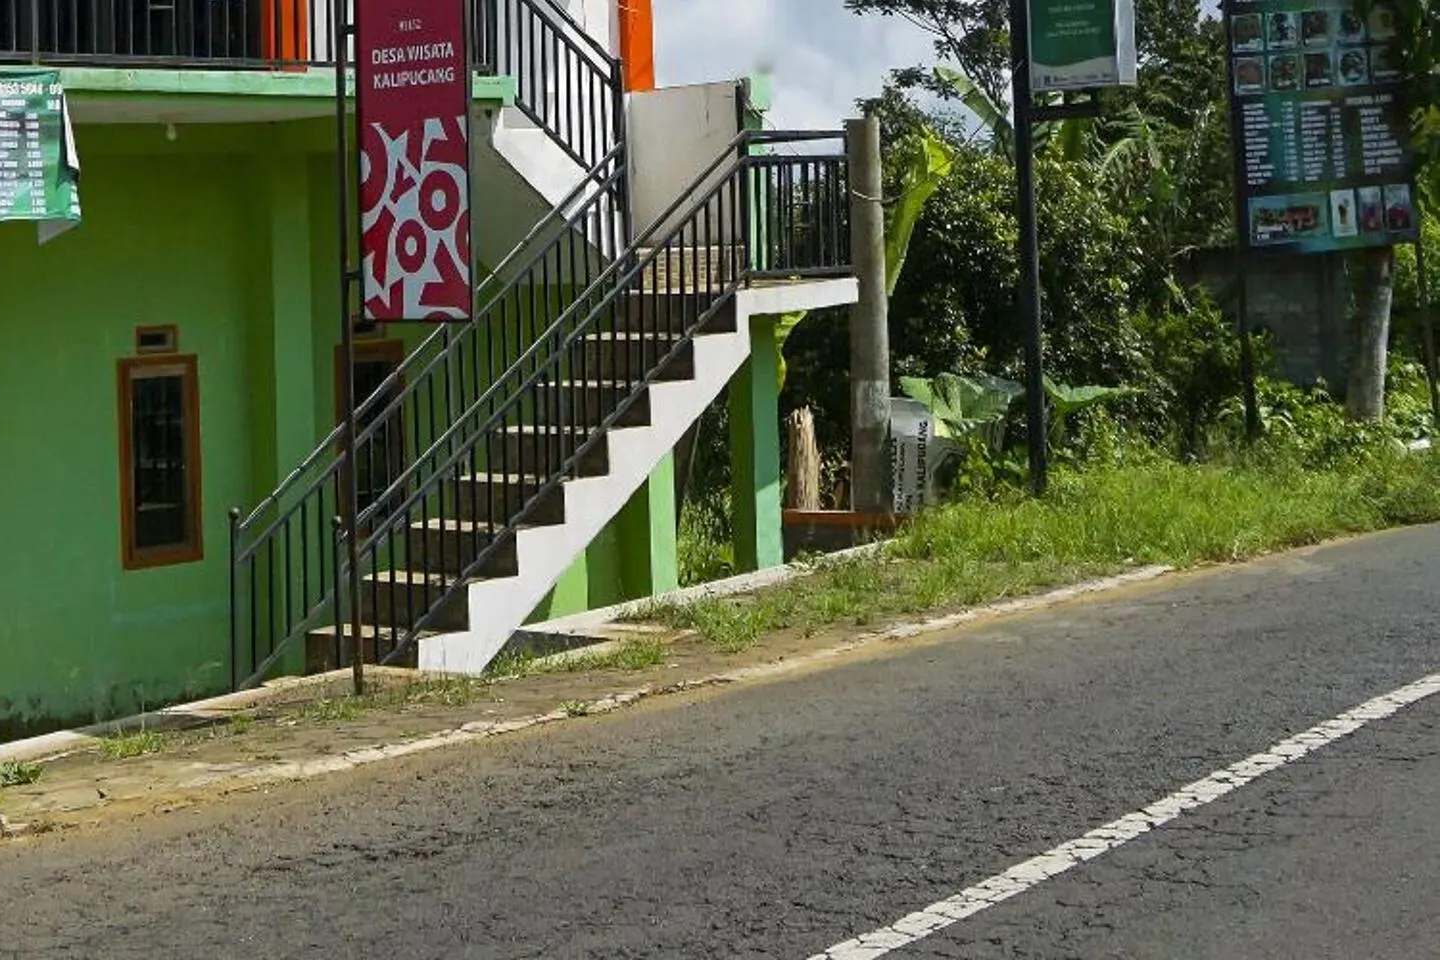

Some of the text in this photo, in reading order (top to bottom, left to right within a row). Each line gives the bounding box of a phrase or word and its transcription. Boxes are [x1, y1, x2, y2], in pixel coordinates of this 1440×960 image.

[372, 42, 454, 64] DESA WISATA
[373, 67, 455, 89] KALIPUCANG
